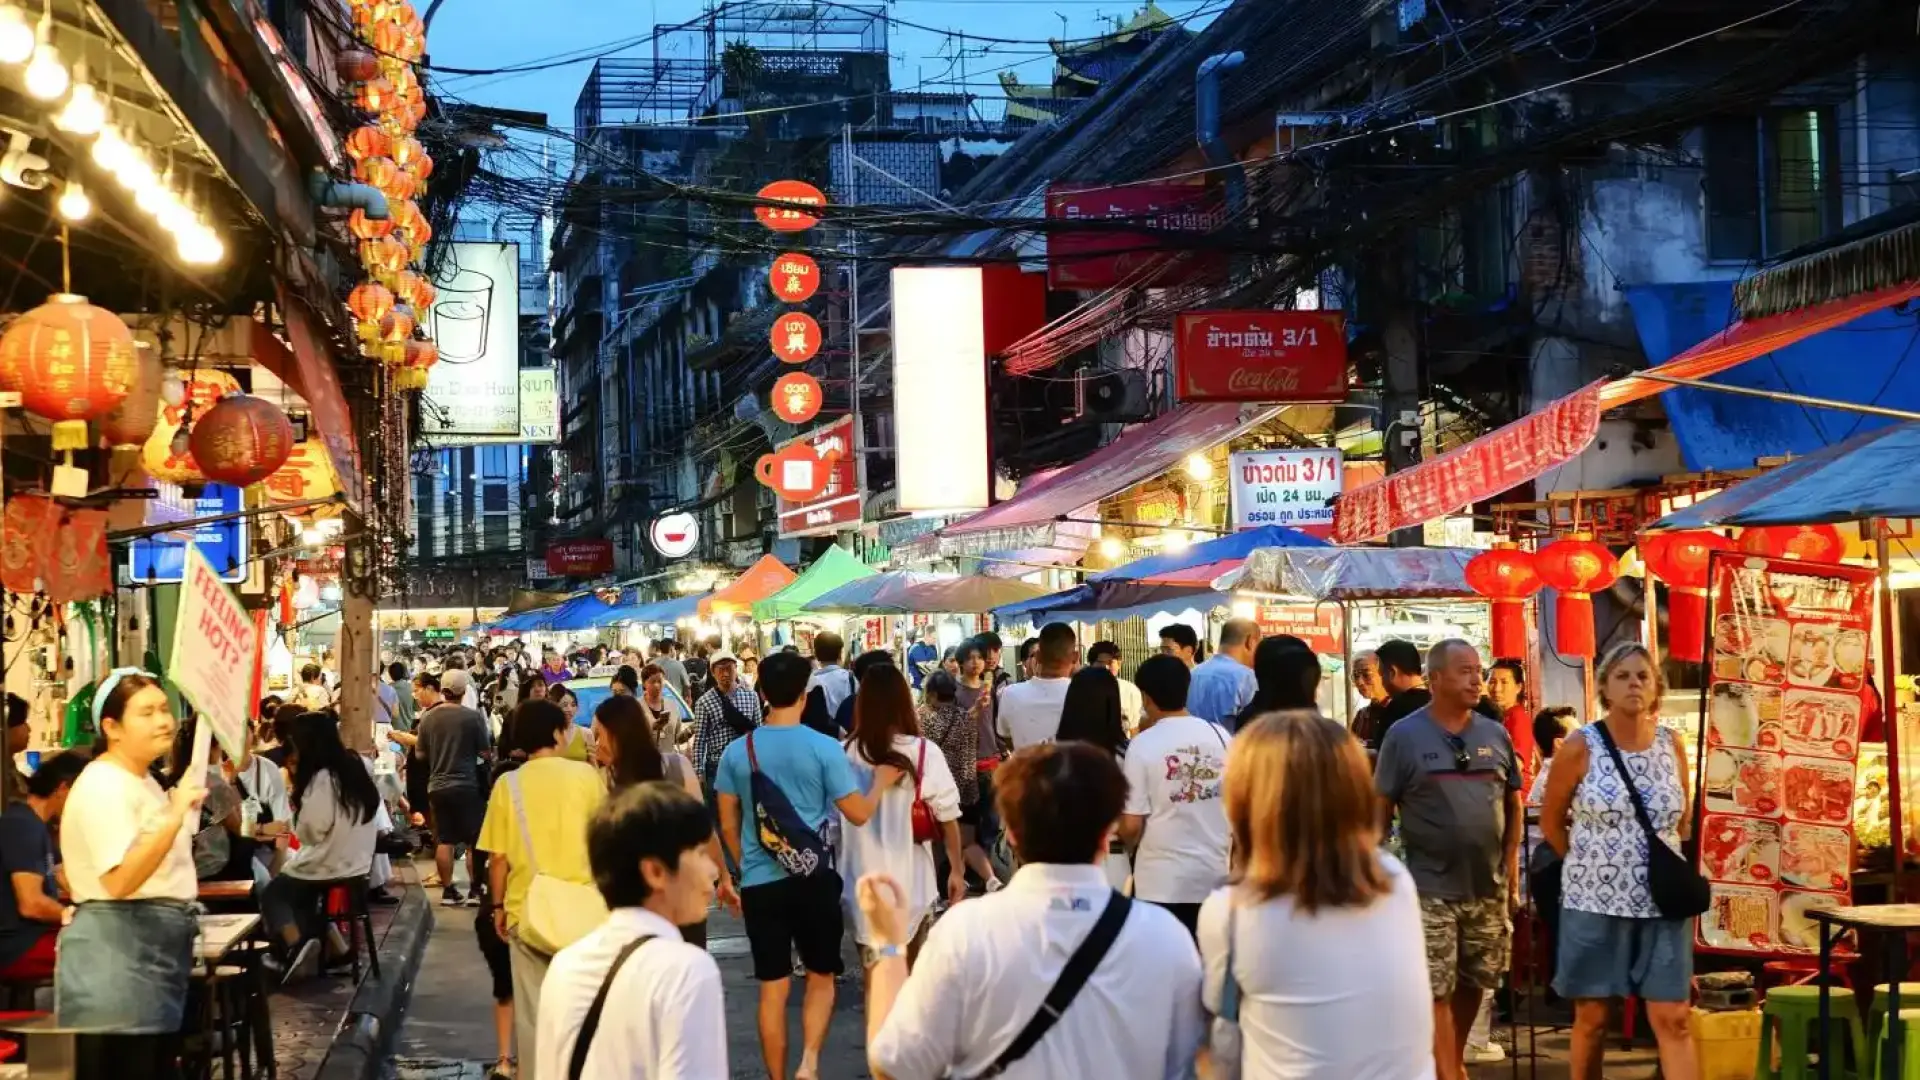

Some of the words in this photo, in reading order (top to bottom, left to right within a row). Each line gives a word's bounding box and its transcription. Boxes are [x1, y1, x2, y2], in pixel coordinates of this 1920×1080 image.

[1206, 324, 1273, 348] ข้าวต้ม
[1282, 327, 1318, 347] 3/1
[522, 425, 554, 437] NEST
[1242, 456, 1298, 485] ข้าวต้ม
[1302, 457, 1337, 482] 3/1
[194, 498, 224, 508] THIS
[1256, 486, 1277, 504] เปิด
[1282, 489, 1299, 502] 24
[193, 567, 251, 653] FEELING
[198, 609, 241, 674] HOT?
